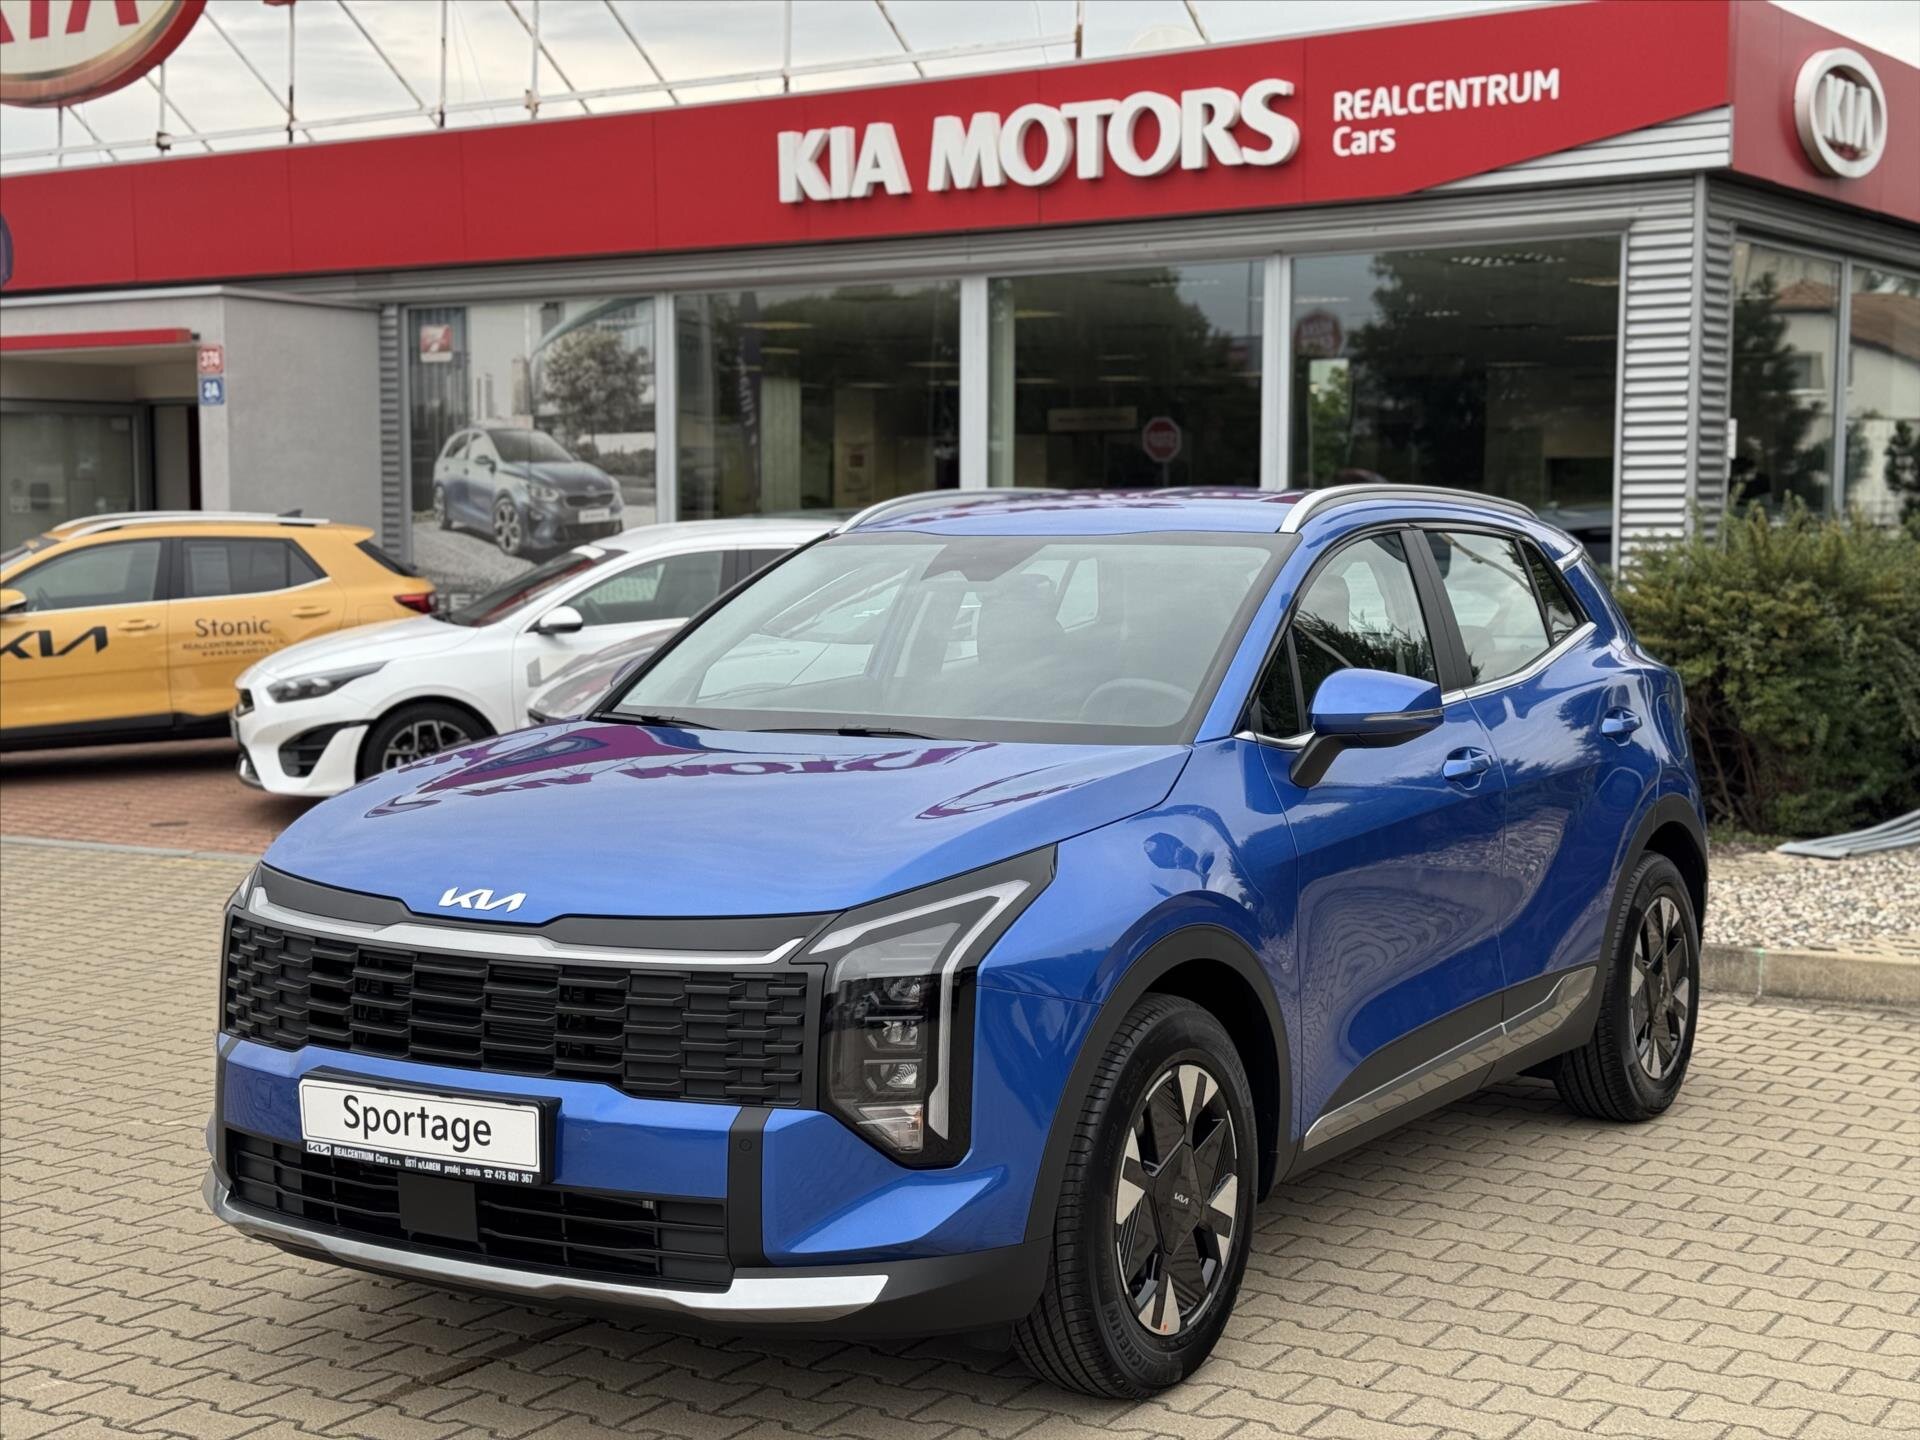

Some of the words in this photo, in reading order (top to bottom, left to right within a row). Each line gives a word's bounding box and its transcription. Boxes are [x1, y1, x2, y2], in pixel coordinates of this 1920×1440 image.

[1333, 68, 1560, 122] REALCENTRUM
[1823, 73, 1875, 149] KIA
[778, 122, 912, 203] KIA
[928, 79, 1299, 192] MOTORS
[1332, 126, 1396, 157] Cars
[204, 381, 220, 398] 2A
[195, 616, 272, 638] Stonic
[438, 887, 527, 913] KIA
[343, 1094, 492, 1153] Sportage
[308, 1143, 331, 1154] KIA
[333, 1146, 375, 1162] REALCENTRUM
[375, 1153, 389, 1164] Cars
[444, 1165, 461, 1176] prodej
[465, 1168, 481, 1177] servis
[494, 1169, 507, 1181] 475
[507, 1172, 520, 1183] 601
[521, 1174, 534, 1184] 367
